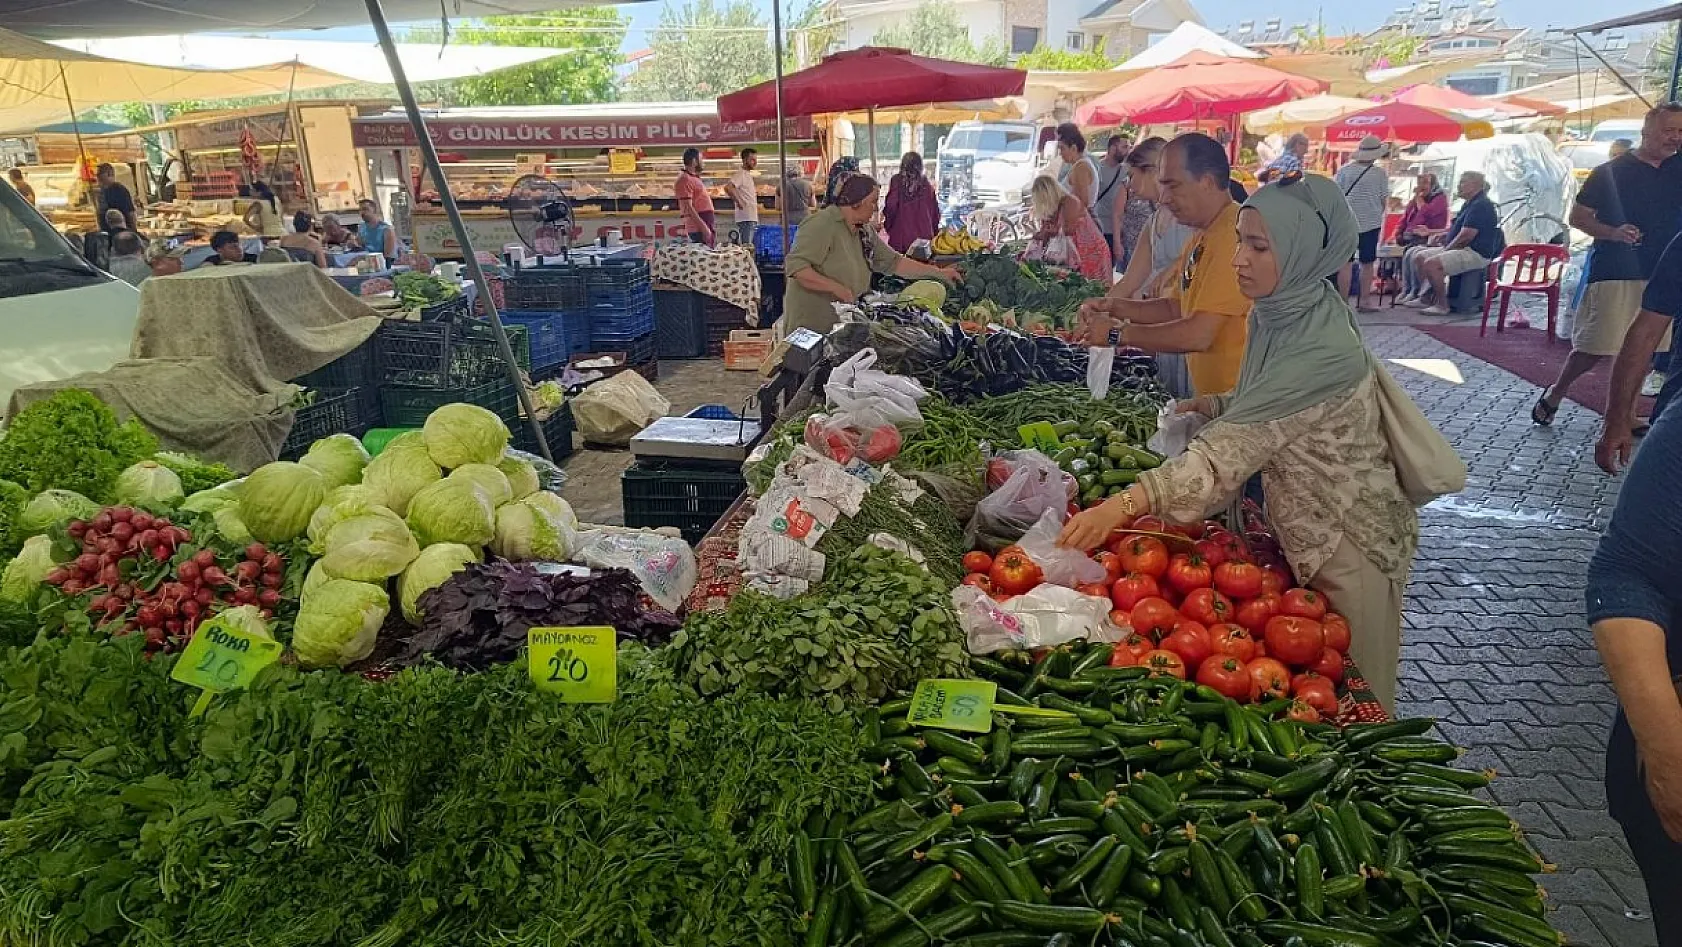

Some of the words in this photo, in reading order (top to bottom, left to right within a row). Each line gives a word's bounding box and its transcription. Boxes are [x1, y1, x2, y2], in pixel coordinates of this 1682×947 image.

[449, 124, 552, 141] GÜNLÜK
[560, 122, 639, 140] KESİM
[646, 120, 712, 141] PİLİÇ
[195, 648, 239, 681] 20
[547, 656, 588, 682] 20
